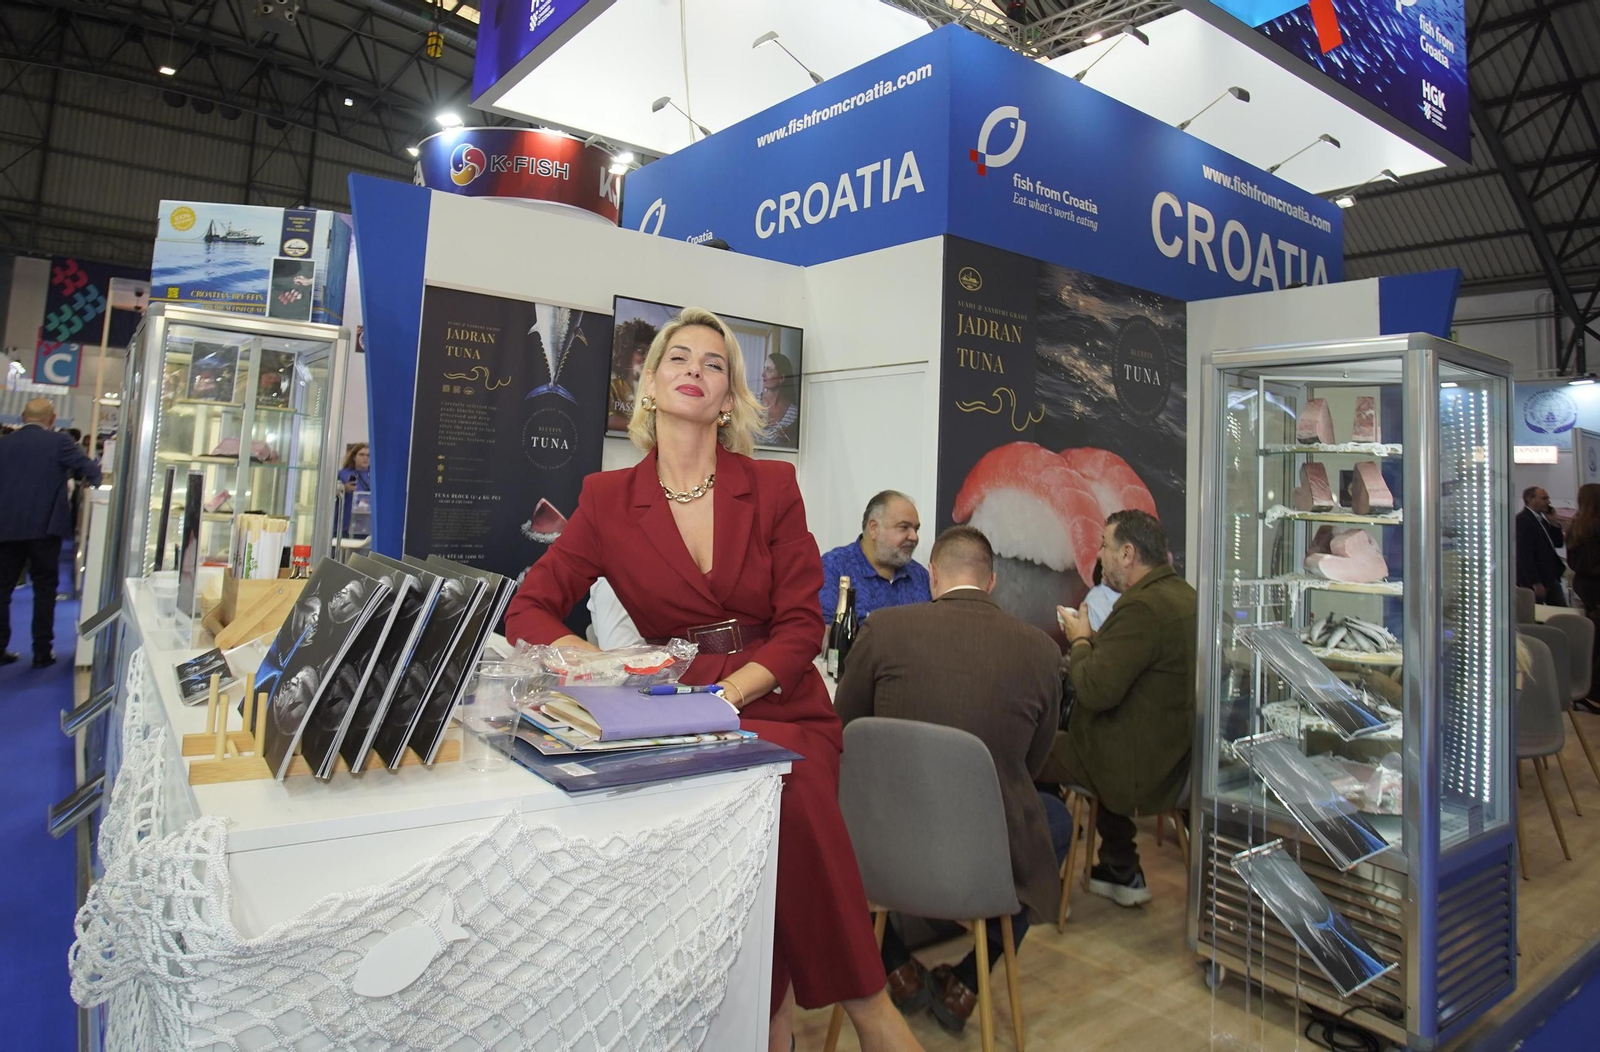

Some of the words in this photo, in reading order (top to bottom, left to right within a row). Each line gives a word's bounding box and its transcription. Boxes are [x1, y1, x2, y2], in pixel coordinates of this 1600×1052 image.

[1419, 14, 1435, 39] fish
[1435, 26, 1454, 54] from
[1420, 35, 1449, 69] Croatia
[757, 63, 932, 148] www.fishfromcroatia.com
[1422, 78, 1447, 112] HGK
[755, 150, 925, 239] CROATIA
[1013, 172, 1034, 192] fish
[1035, 181, 1060, 202] from
[1062, 190, 1098, 215] Croatia
[1202, 164, 1331, 234] www.fishfromcroatia.com
[1013, 192, 1027, 206] Eat
[1028, 199, 1053, 215] what's
[1053, 207, 1075, 222] worth
[1076, 216, 1098, 232] eating
[686, 229, 713, 244] Croatia
[1151, 191, 1329, 291] CROATIA
[446, 327, 496, 344] JADRAN
[957, 313, 1022, 344] JADRAN
[43, 352, 73, 384] C
[445, 345, 481, 360] TUNA
[956, 347, 1005, 374] TUNA
[1123, 363, 1161, 386] TUNA
[531, 436, 568, 450] TUNA
